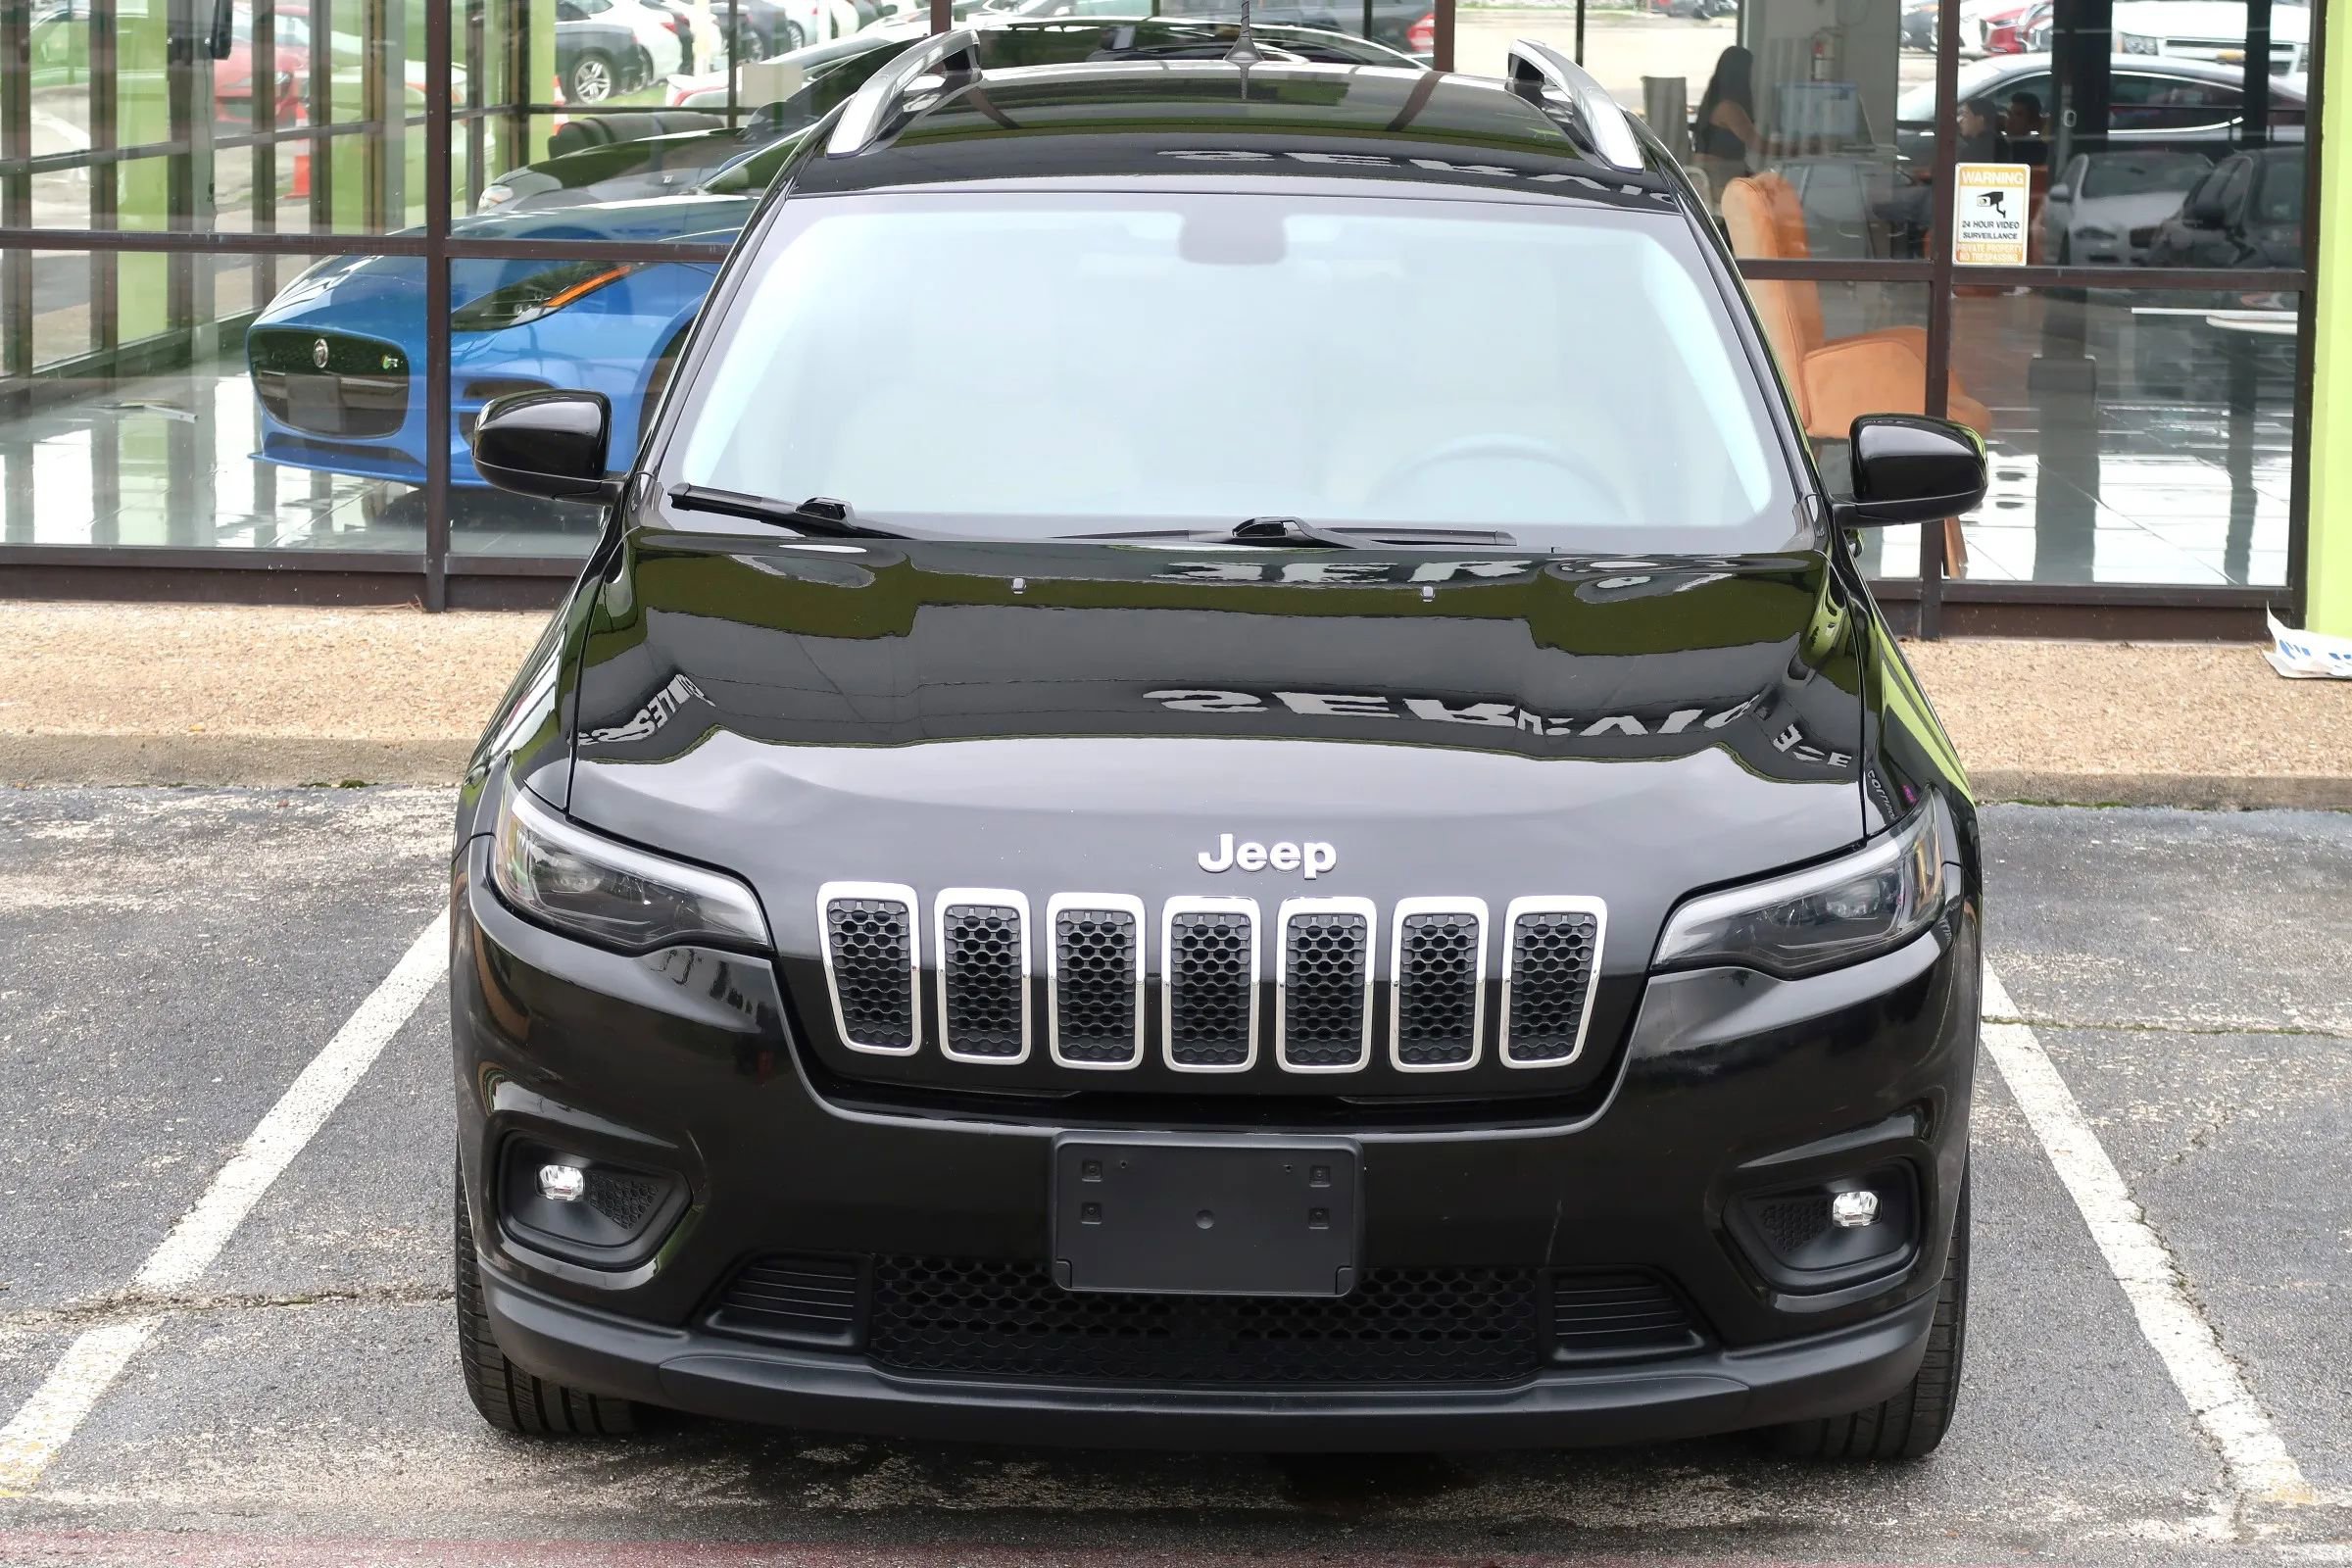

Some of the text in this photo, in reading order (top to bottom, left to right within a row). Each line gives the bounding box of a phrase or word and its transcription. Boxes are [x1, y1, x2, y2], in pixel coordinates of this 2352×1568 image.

[1962, 171, 2024, 184] WARNING
[1996, 220, 2020, 229] VIDEO
[1963, 231, 2018, 240] SURVEILLANCE
[1198, 833, 1337, 880] Jeep
